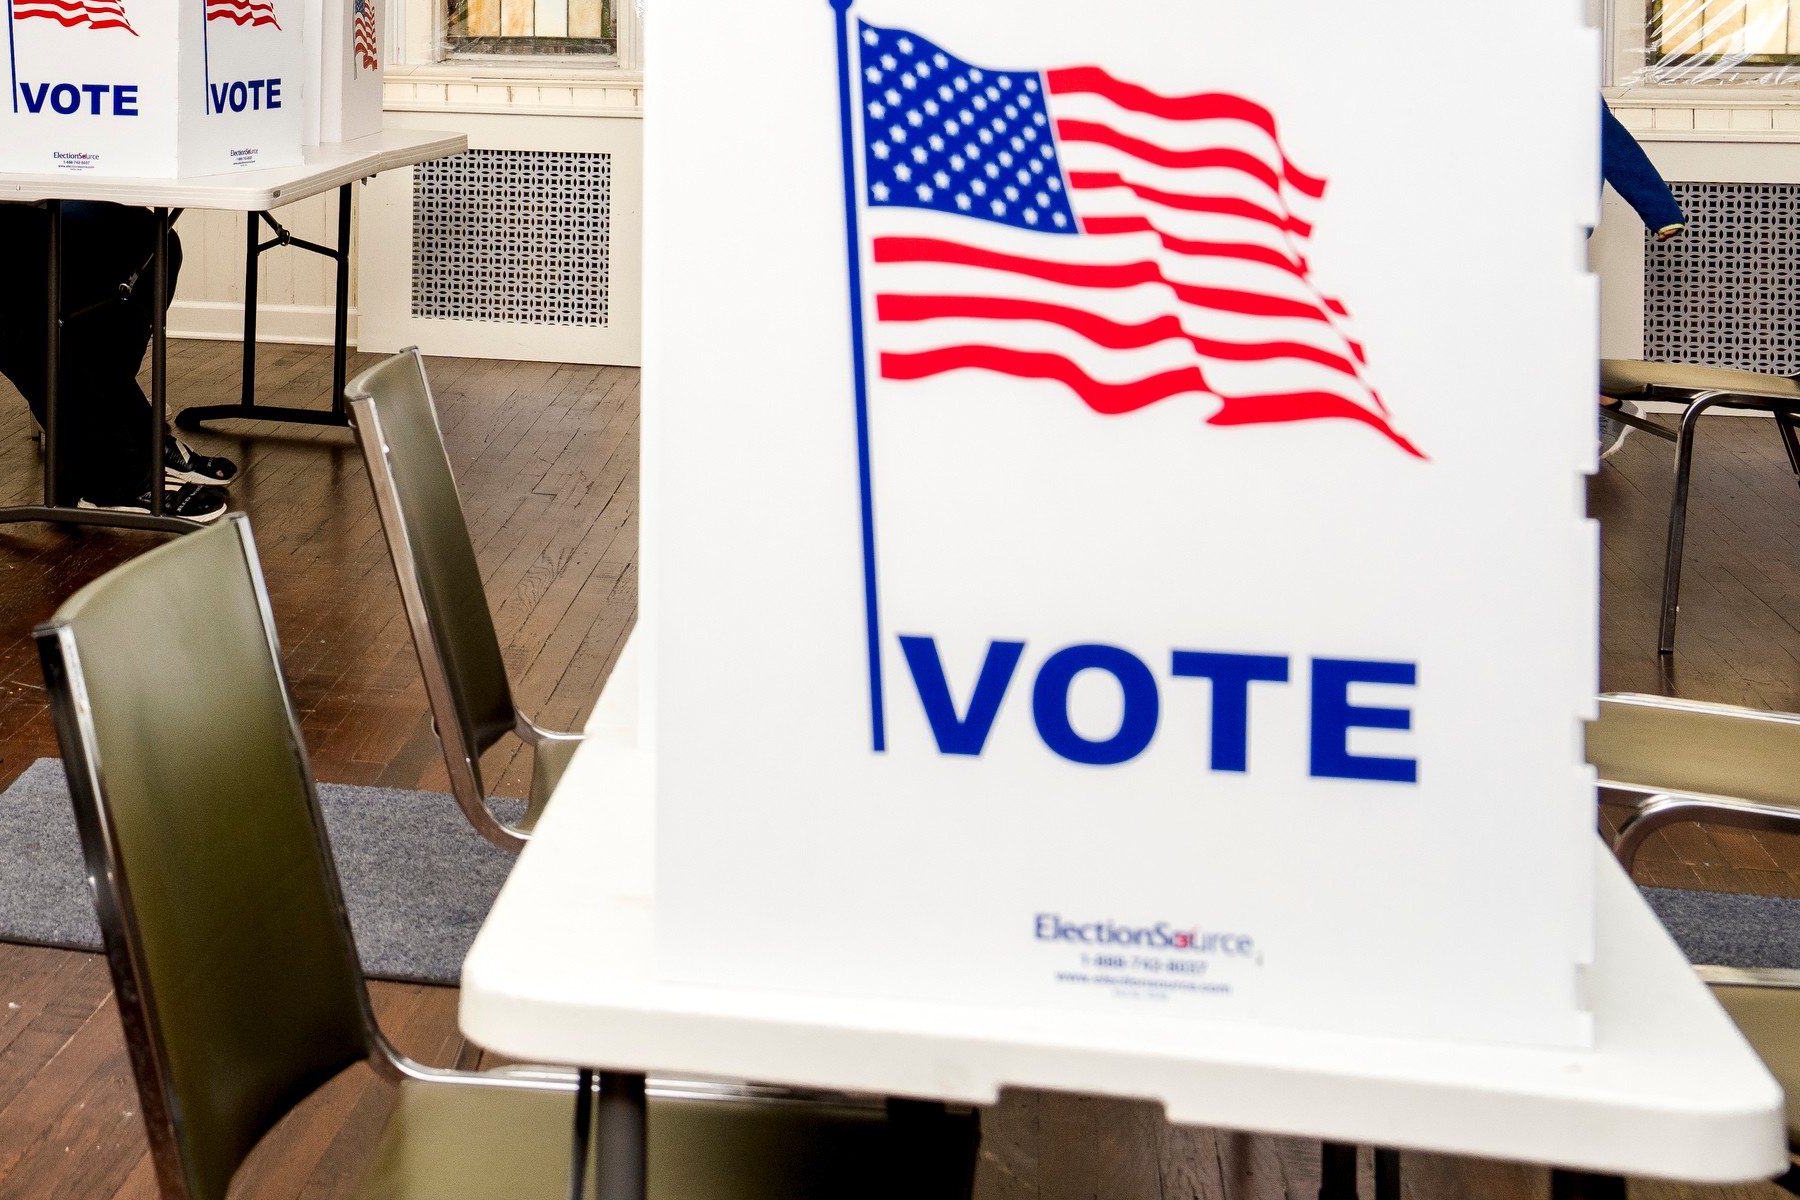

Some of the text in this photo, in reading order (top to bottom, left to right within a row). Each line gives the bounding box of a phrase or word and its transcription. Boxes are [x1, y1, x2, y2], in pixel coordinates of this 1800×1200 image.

[20, 82, 139, 117] VOTE
[210, 78, 282, 115] VOTE
[53, 151, 100, 161] ElectionSource
[897, 633, 1419, 785] VOTE
[1034, 912, 1255, 954] ElectionSource
